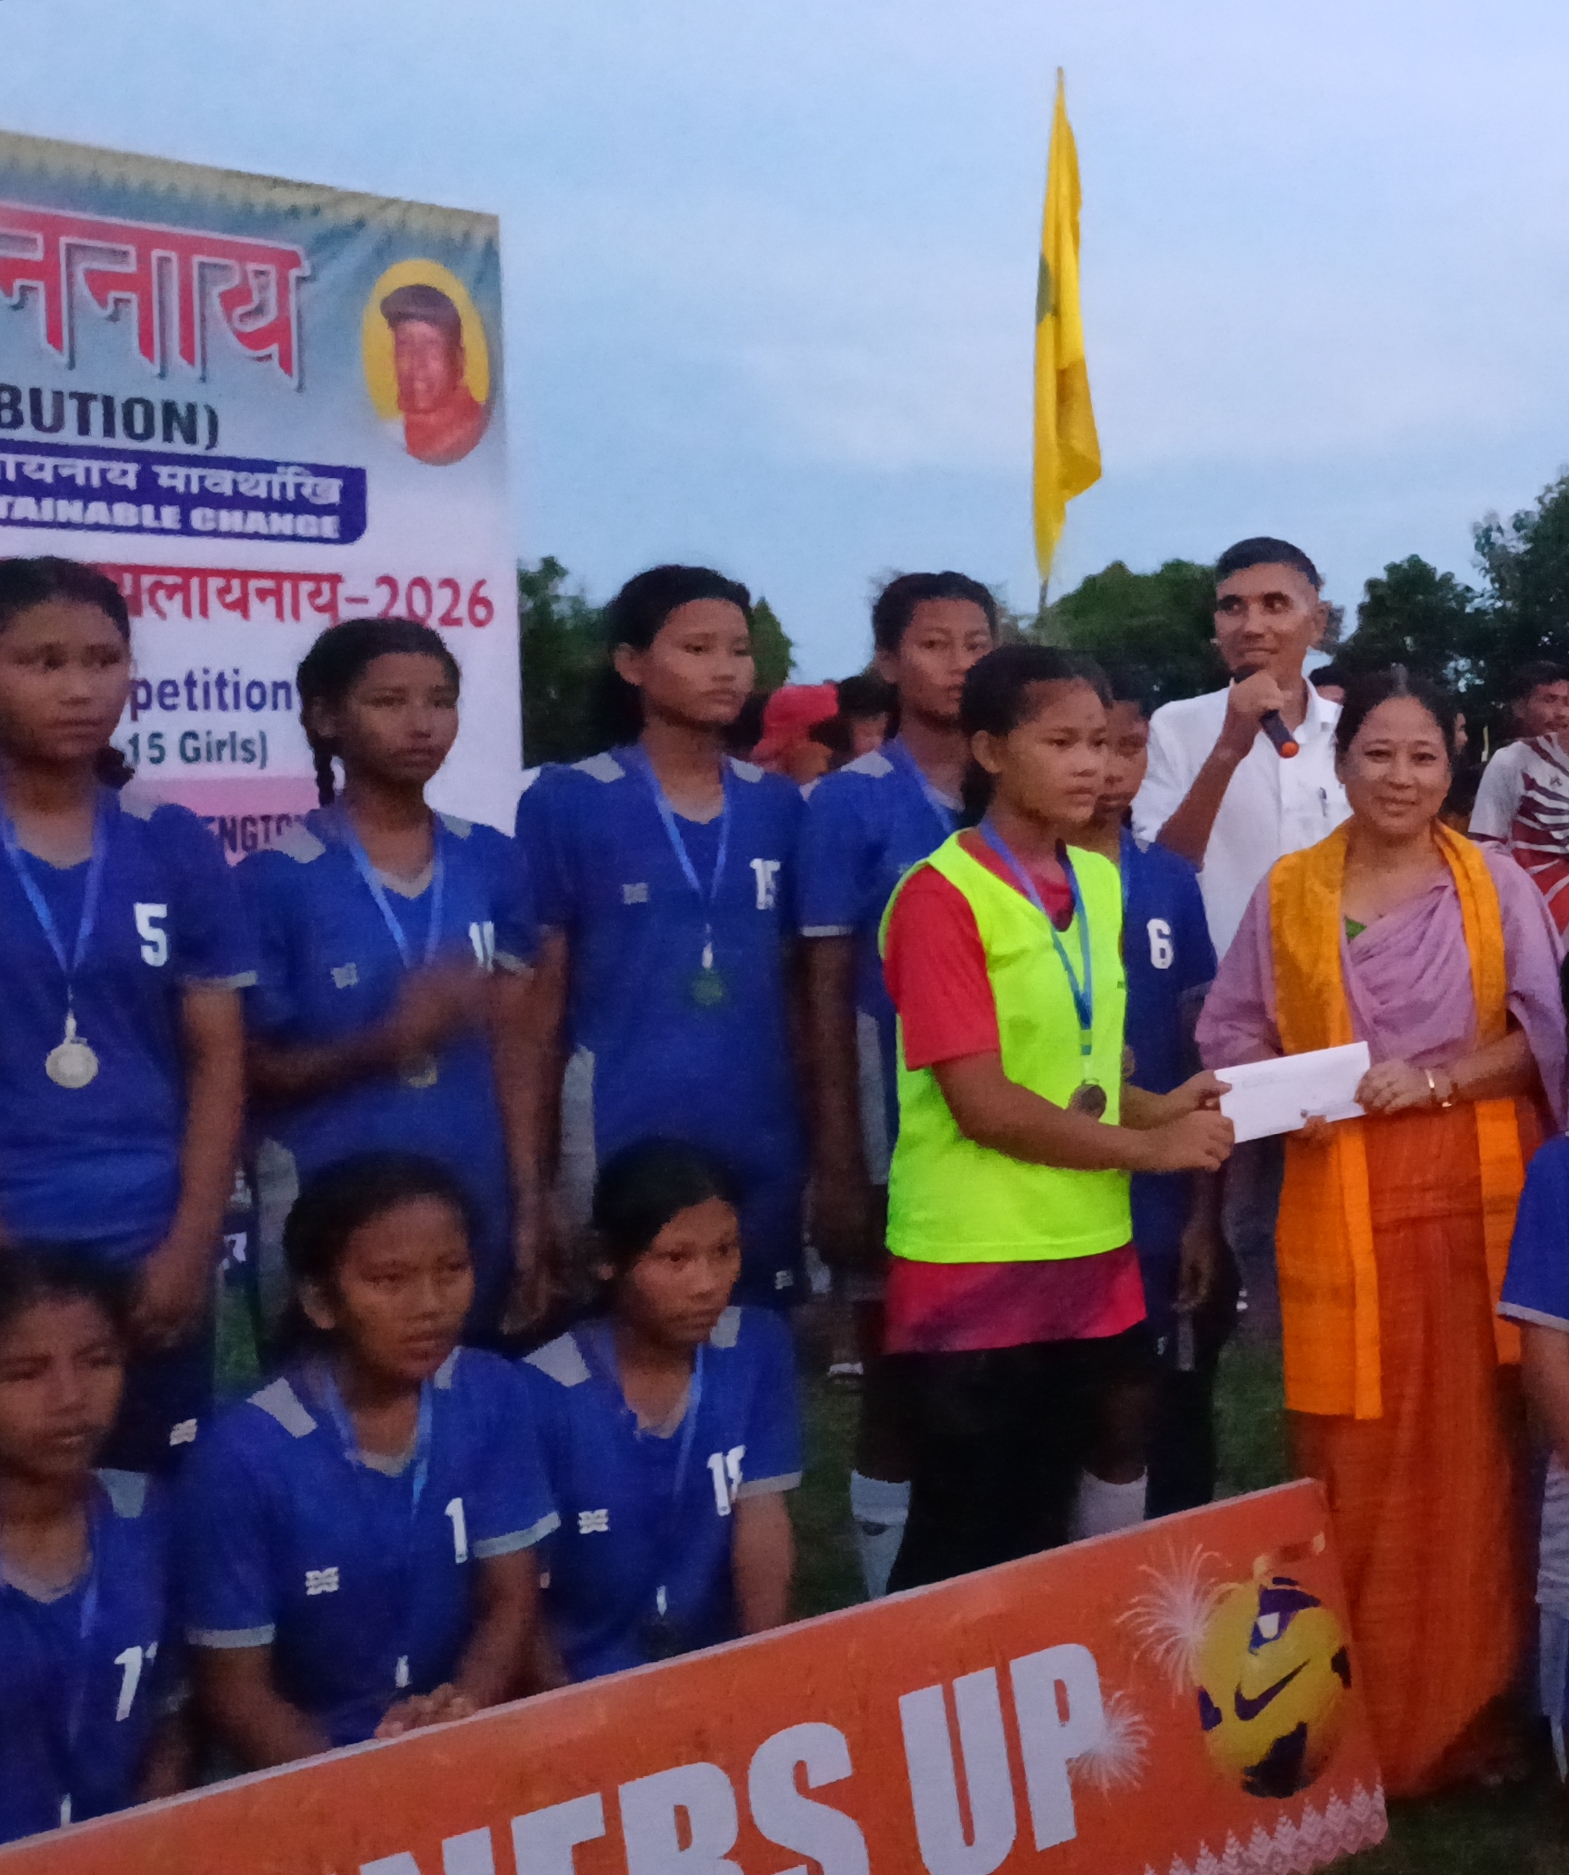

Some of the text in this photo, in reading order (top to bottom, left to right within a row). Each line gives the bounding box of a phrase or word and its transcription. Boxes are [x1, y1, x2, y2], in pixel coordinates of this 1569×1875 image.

[130, 667, 293, 722] petition
[179, 729, 268, 770] Girls)
[134, 902, 168, 967] 5
[1147, 918, 1174, 969] 6
[445, 1498, 469, 1563] 1
[899, 1643, 1103, 1875] UP
